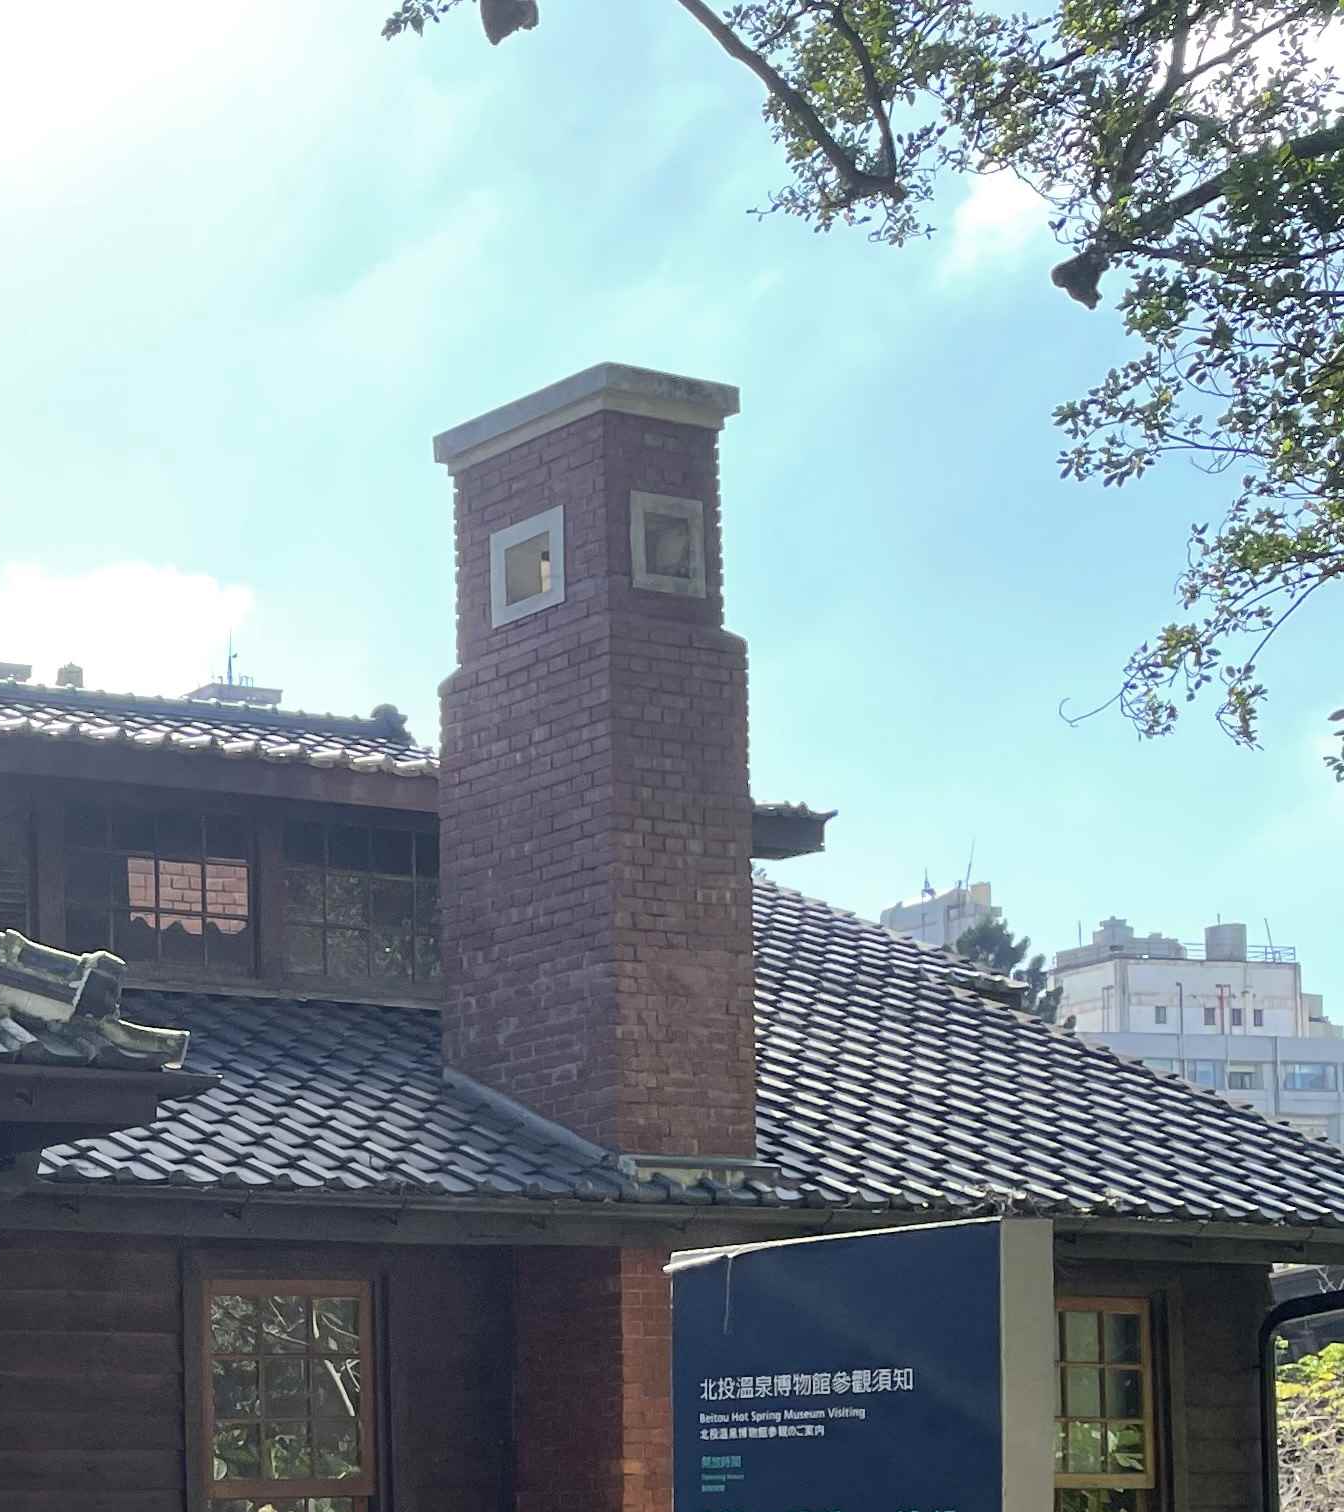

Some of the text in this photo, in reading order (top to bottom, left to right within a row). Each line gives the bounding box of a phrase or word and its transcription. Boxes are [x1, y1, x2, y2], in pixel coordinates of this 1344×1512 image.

[699, 1368, 913, 1401] 北投溫泉博物館參觀須知
[699, 1406, 866, 1424] Beitou Hot Spring Museum Visiting
